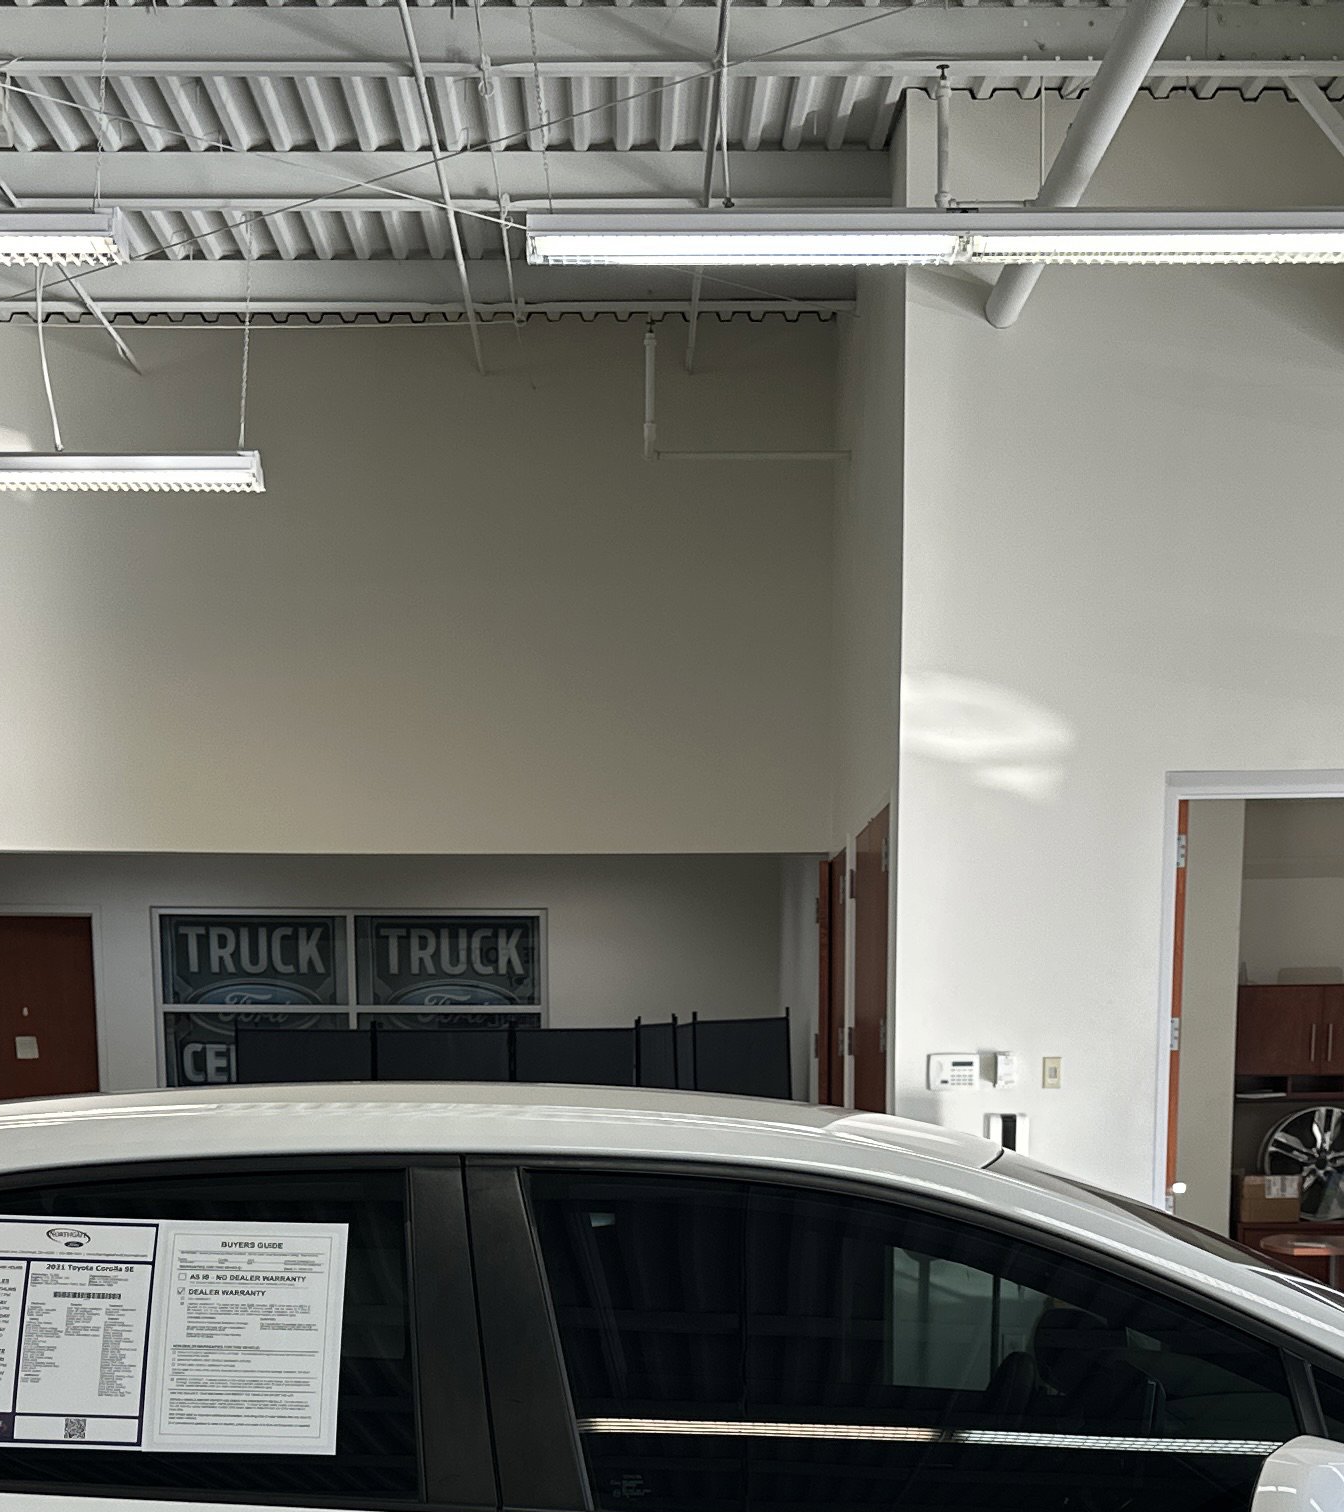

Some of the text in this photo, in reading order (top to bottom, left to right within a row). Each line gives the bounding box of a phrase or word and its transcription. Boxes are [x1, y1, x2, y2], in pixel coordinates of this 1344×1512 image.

[178, 926, 326, 974] TRUCK
[379, 927, 525, 976] TRUCK
[221, 1241, 255, 1249] BUYERS
[67, 1264, 94, 1273] Toyota
[189, 1273, 201, 1281] AS
[229, 1274, 261, 1282] DEALER
[262, 1275, 307, 1283] WARRANTY
[188, 1288, 266, 1297] DEALER WARRANTY
